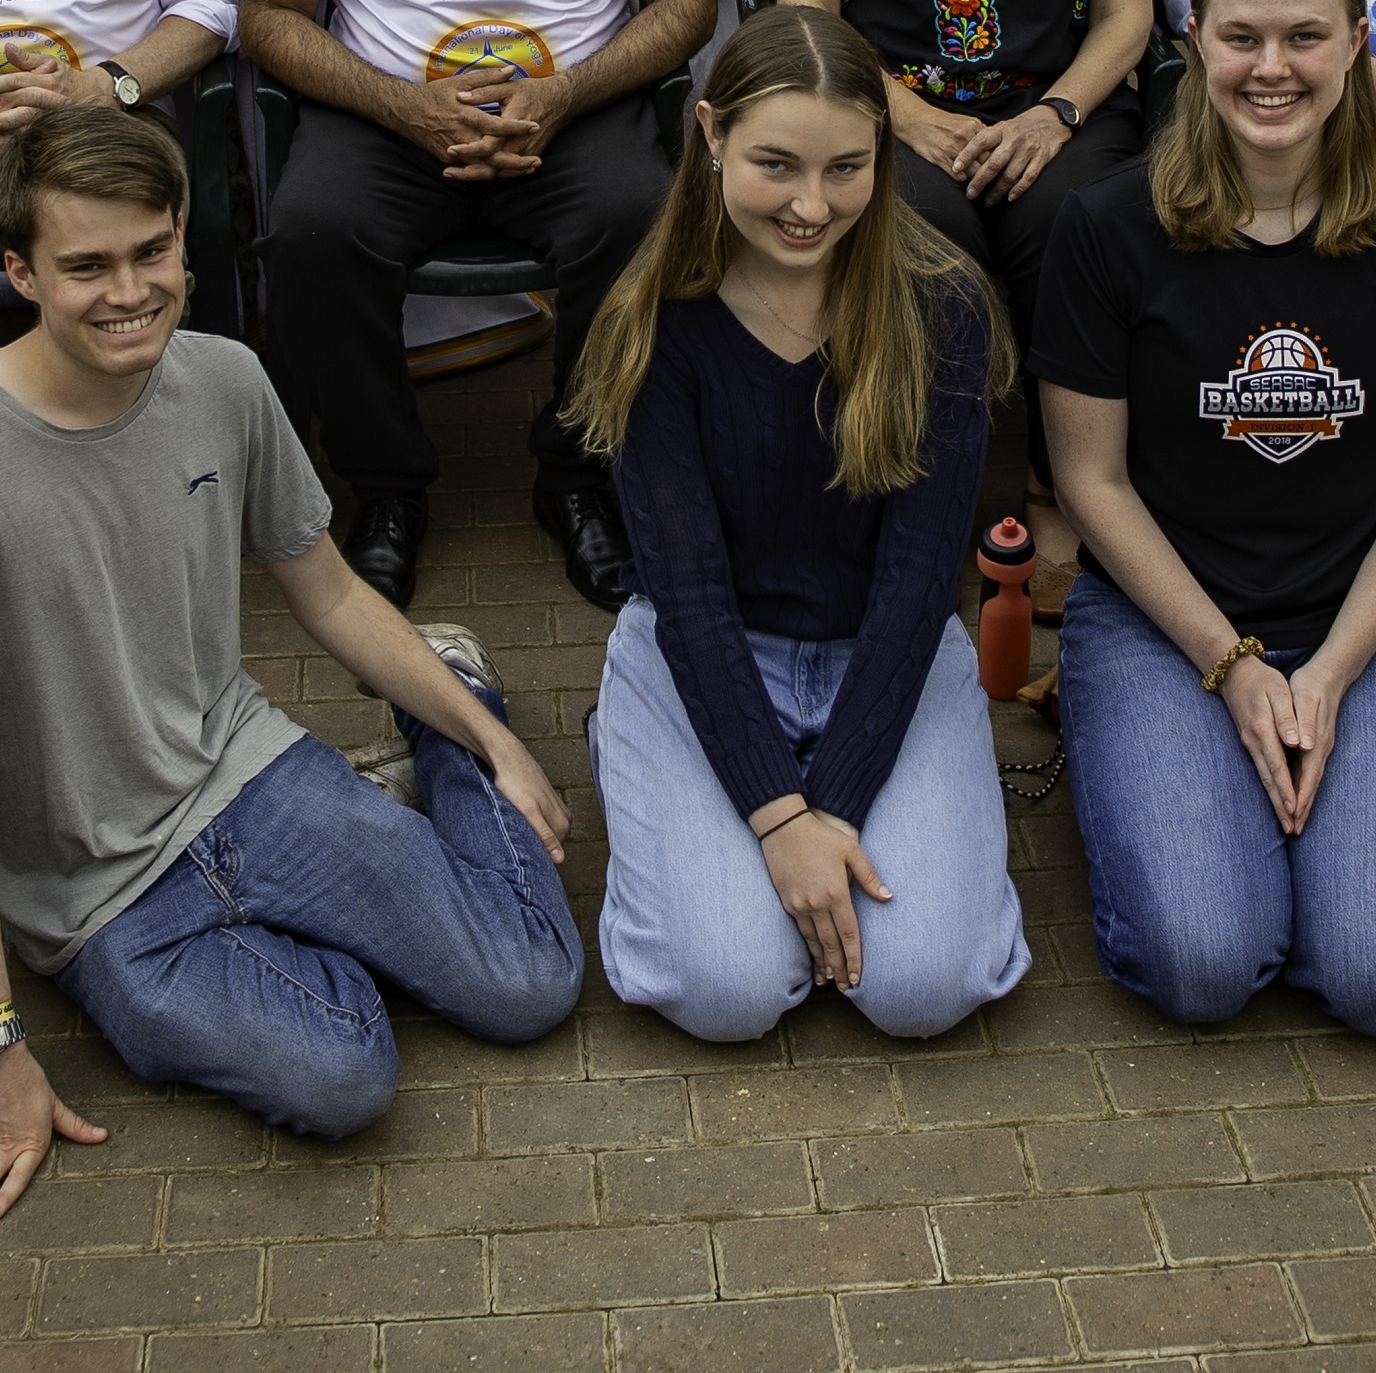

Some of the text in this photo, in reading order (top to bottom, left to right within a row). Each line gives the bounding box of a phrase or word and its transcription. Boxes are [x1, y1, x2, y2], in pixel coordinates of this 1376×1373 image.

[18, 29, 42, 42] Day
[44, 38, 57, 49] of
[489, 25, 512, 37] Day
[514, 32, 527, 42] of
[526, 38, 544, 66] Yoga
[494, 44, 513, 53] June
[1250, 376, 1316, 390] SEASAC
[1207, 388, 1357, 413] BASKETBALL
[1251, 423, 1304, 431] DIVISION
[1268, 437, 1291, 445] 2018
